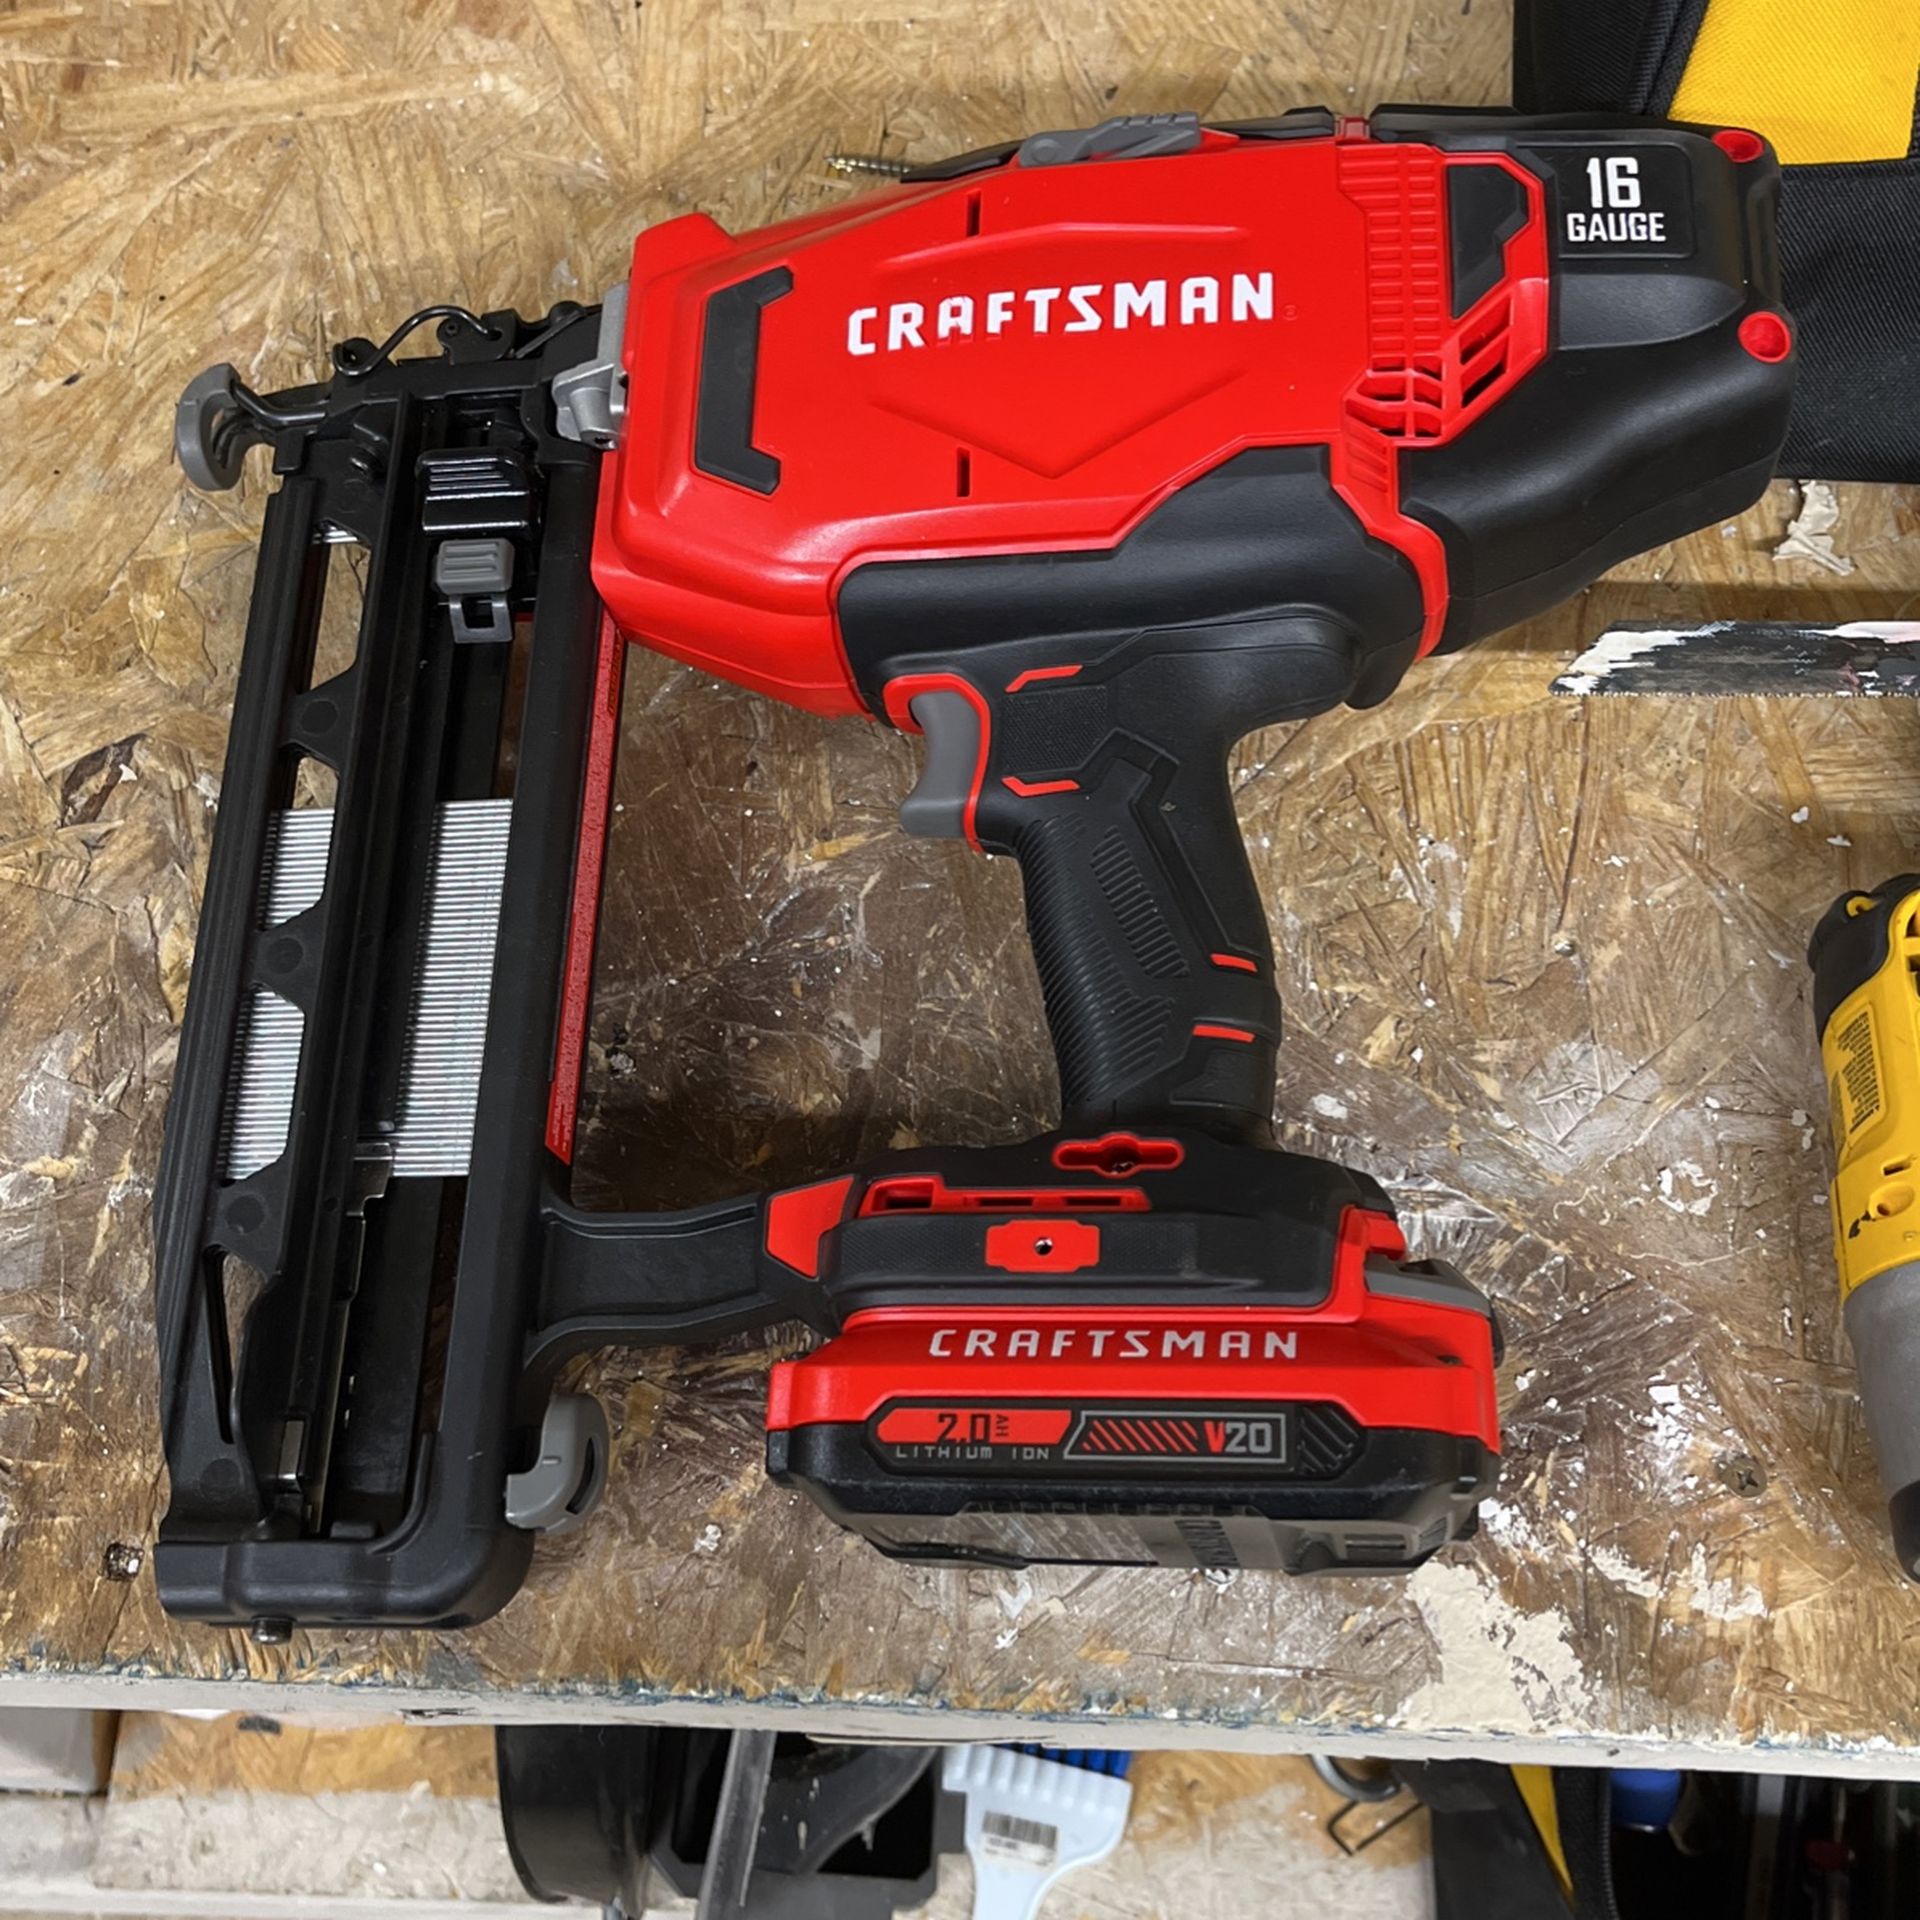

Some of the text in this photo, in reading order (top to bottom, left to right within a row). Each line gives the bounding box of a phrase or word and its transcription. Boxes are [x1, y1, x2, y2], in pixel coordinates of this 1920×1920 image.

[1586, 157, 1641, 209] 16
[1567, 212, 1666, 242] GAUGE
[847, 272, 1273, 356] CRAFTSMAN
[929, 1328, 1297, 1360] CRAFTSMAN
[937, 1413, 991, 1444] 2.0
[1204, 1420, 1272, 1454] V20
[896, 1446, 1049, 1461] LITHIUM ION
